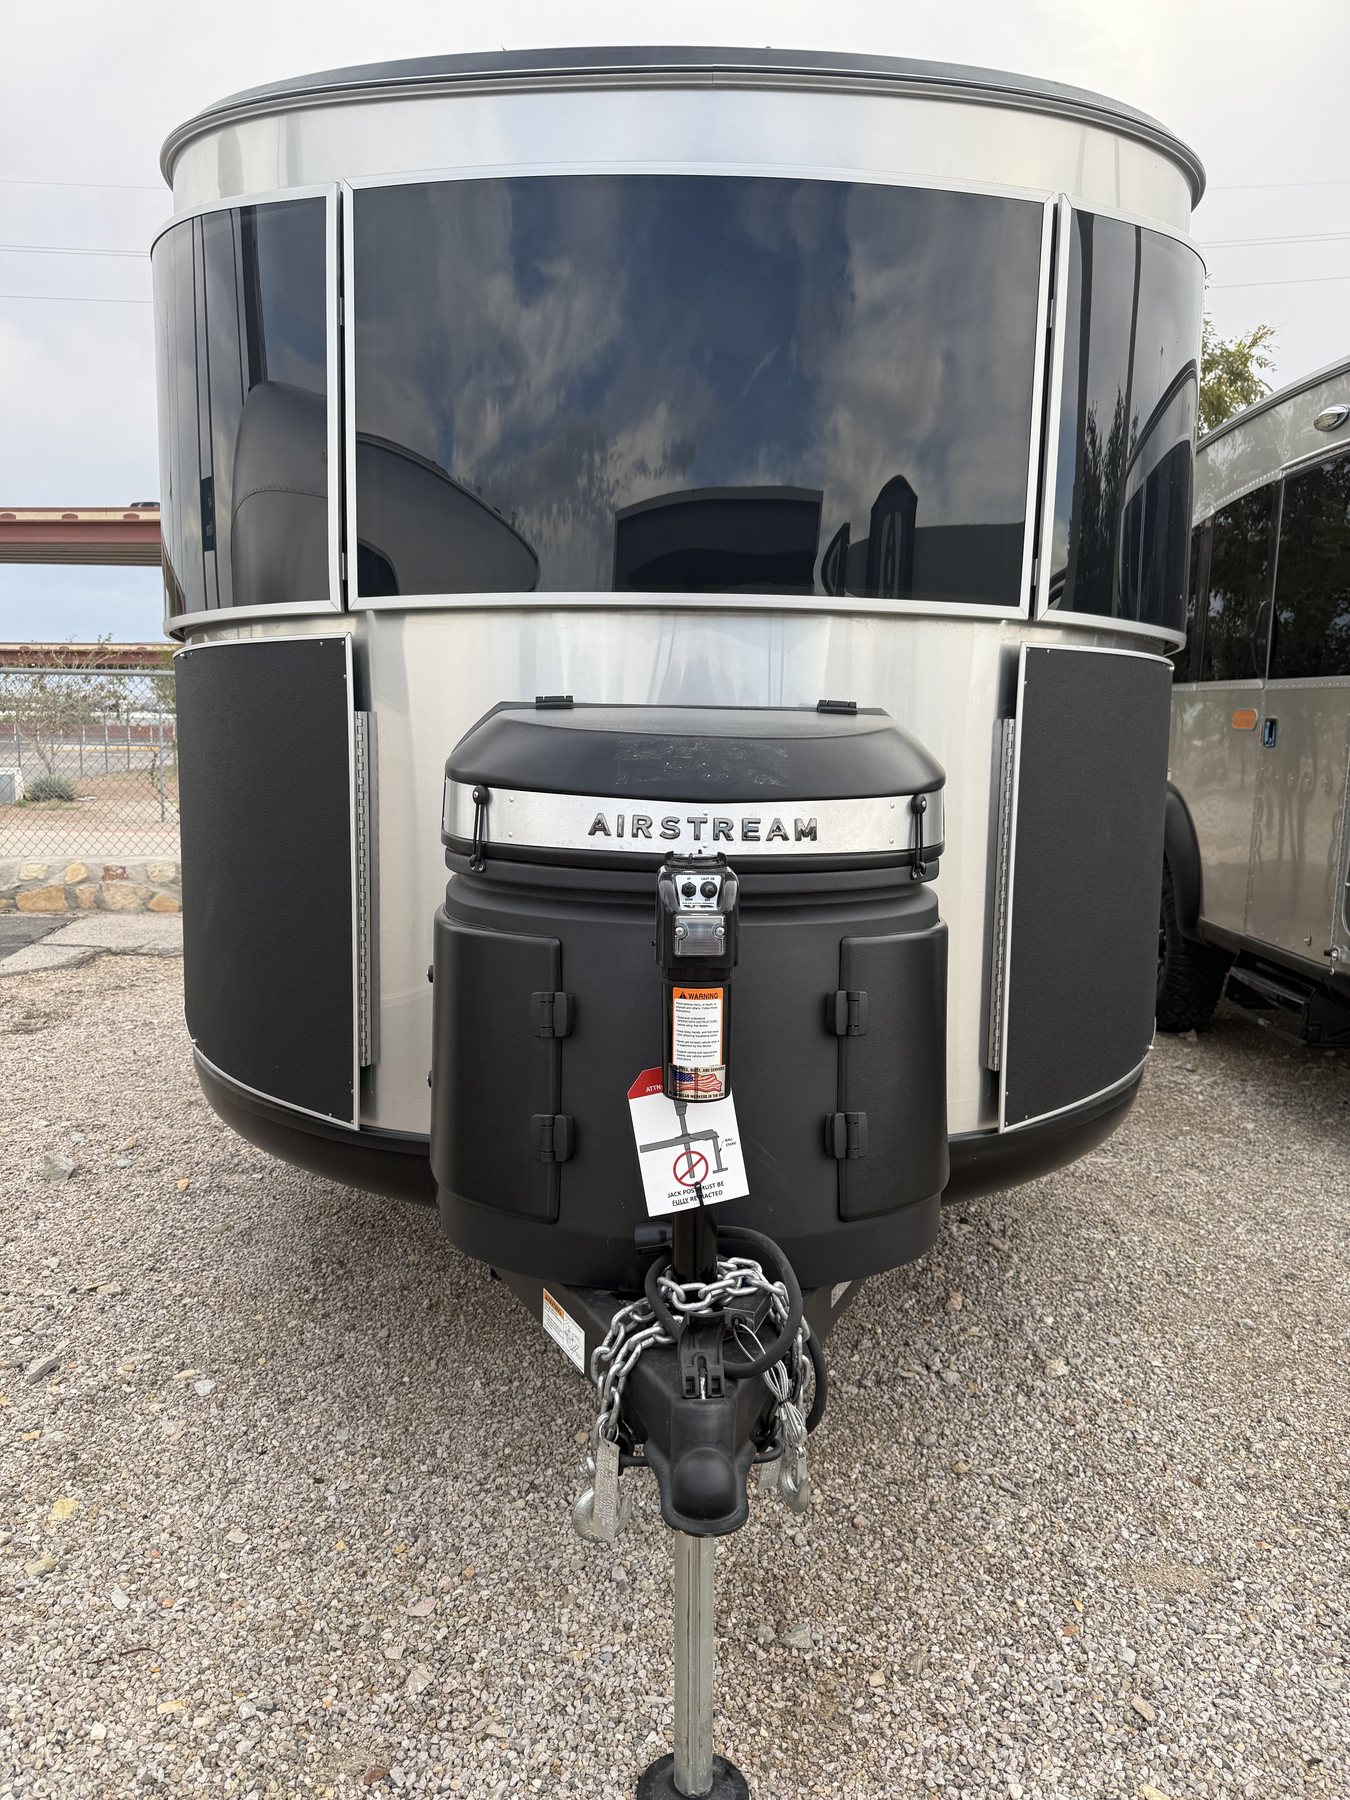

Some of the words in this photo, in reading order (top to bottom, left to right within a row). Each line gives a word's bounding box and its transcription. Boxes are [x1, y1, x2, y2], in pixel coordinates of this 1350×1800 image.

[588, 812, 818, 842] AIRSTREAM
[668, 1190, 682, 1198] JACK
[672, 1198, 689, 1206] FULLY
